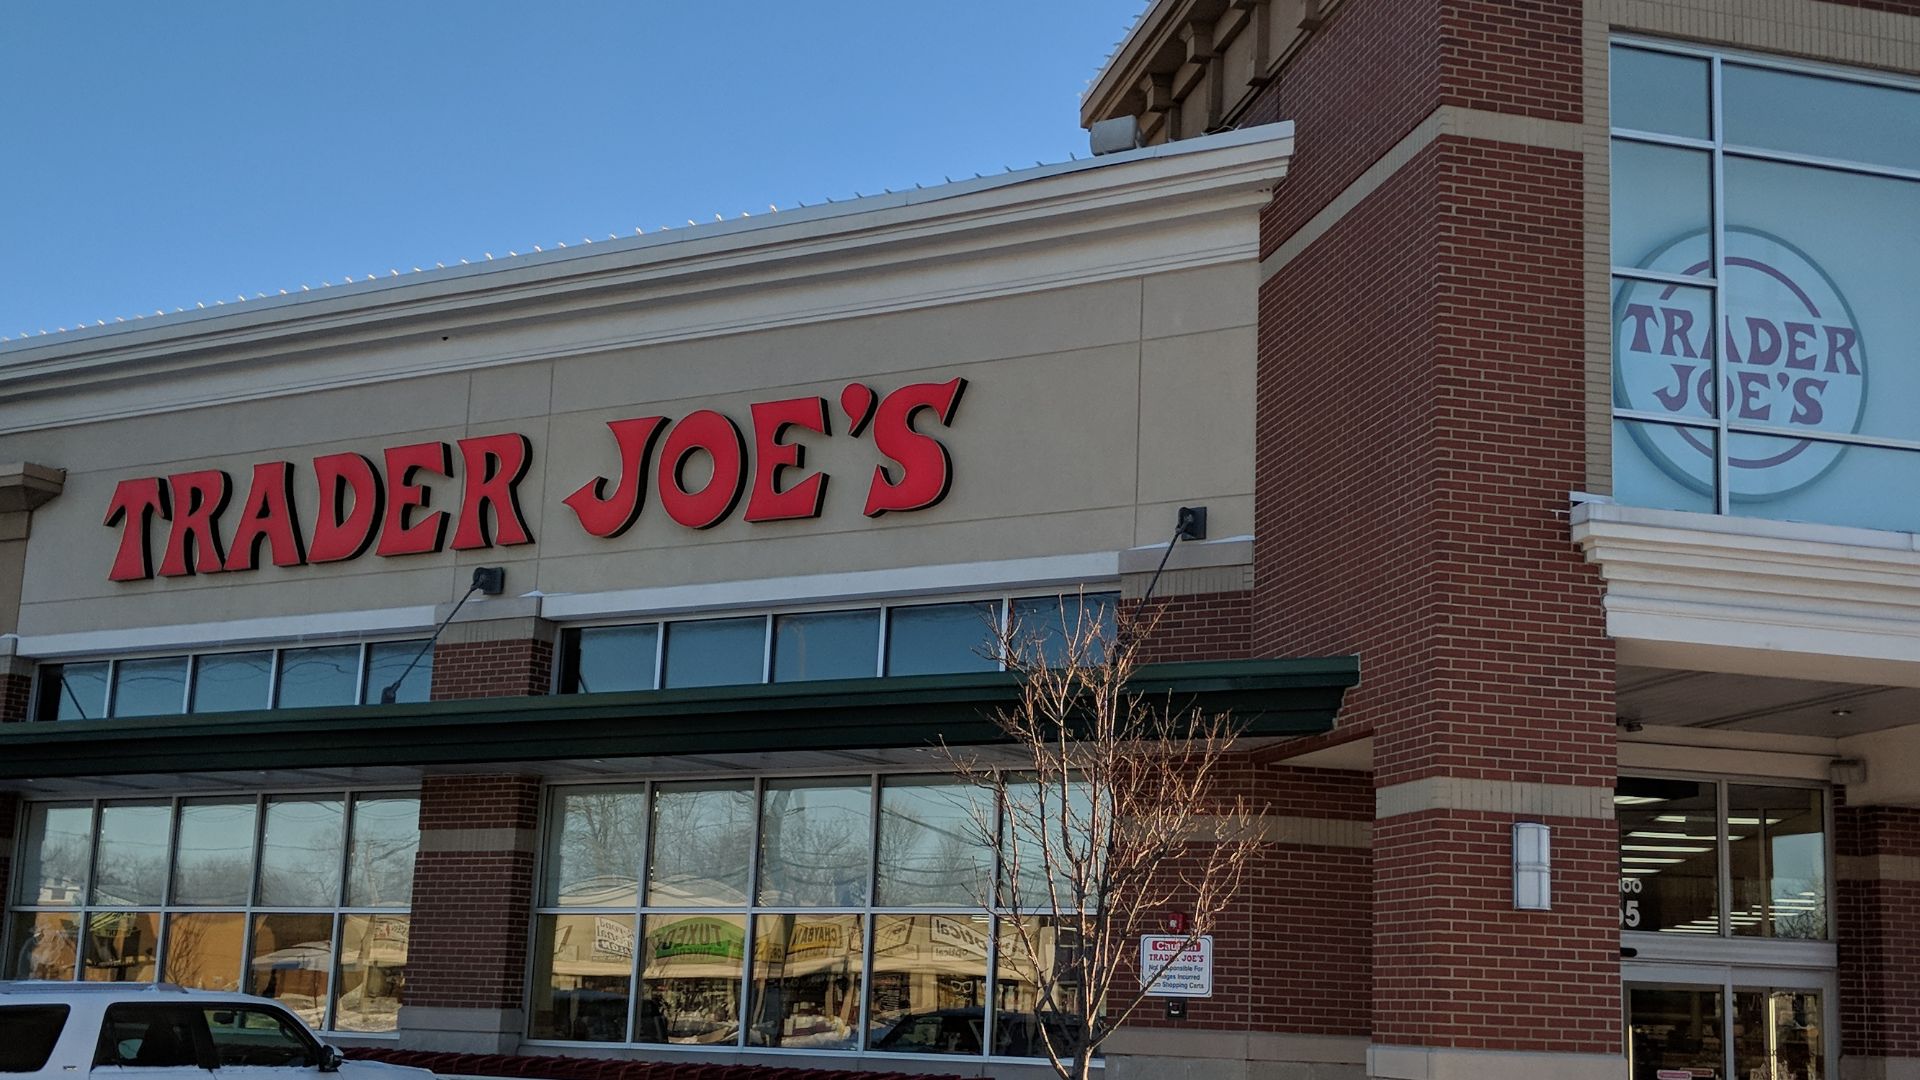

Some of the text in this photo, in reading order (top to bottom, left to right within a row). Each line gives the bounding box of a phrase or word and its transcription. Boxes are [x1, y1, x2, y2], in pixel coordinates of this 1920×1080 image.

[1622, 303, 1861, 375] TRADER
[1652, 363, 1829, 425] JOE'S
[103, 376, 969, 583] TRADER JOE'S
[1149, 954, 1204, 963] TRAD JOE'S
